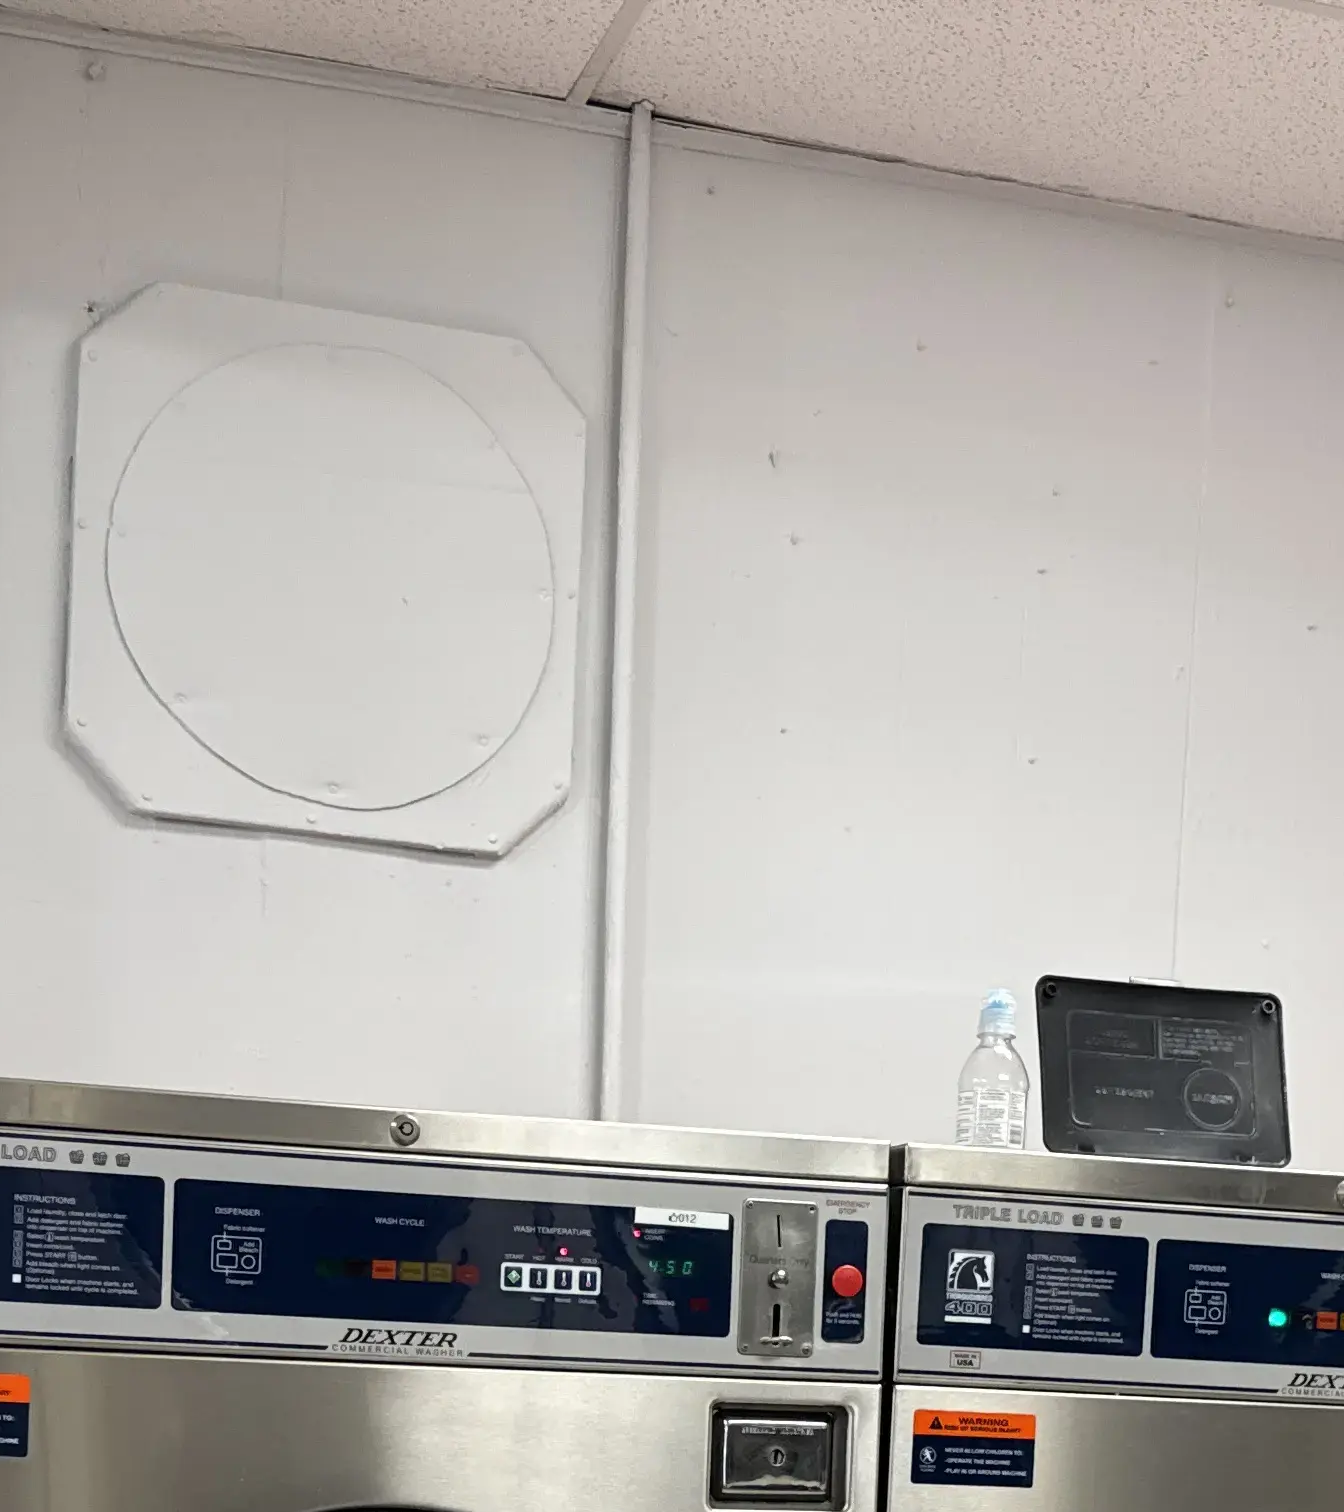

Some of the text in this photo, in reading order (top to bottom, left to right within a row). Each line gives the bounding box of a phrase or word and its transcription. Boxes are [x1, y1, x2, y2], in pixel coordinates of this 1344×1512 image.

[1, 1144, 57, 1162] LOAD
[953, 1204, 1064, 1226] TRIPLE LOAD
[375, 1217, 424, 1227] WASH CYCLE
[513, 1225, 592, 1237] WASH TEMPERATURE
[339, 1328, 458, 1347] DEXTER
[332, 1344, 409, 1354] COMMERCIAL
[959, 1417, 1008, 1426] WARNING
